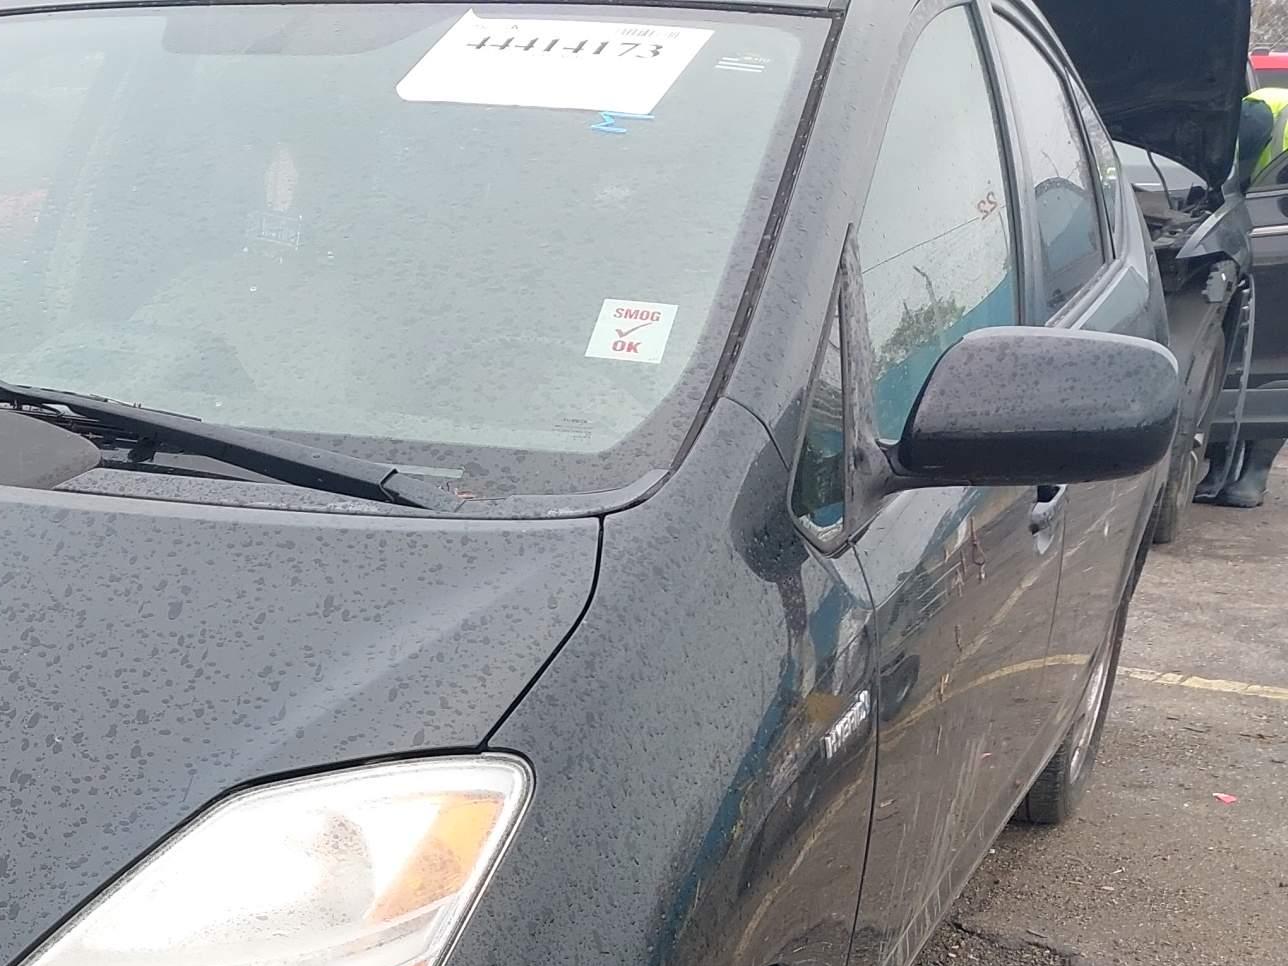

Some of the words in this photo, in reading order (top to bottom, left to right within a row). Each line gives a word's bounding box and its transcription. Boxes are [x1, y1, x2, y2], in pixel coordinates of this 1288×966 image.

[466, 35, 664, 59] 44414173
[613, 307, 662, 322] SMOG
[611, 339, 641, 354] OK
